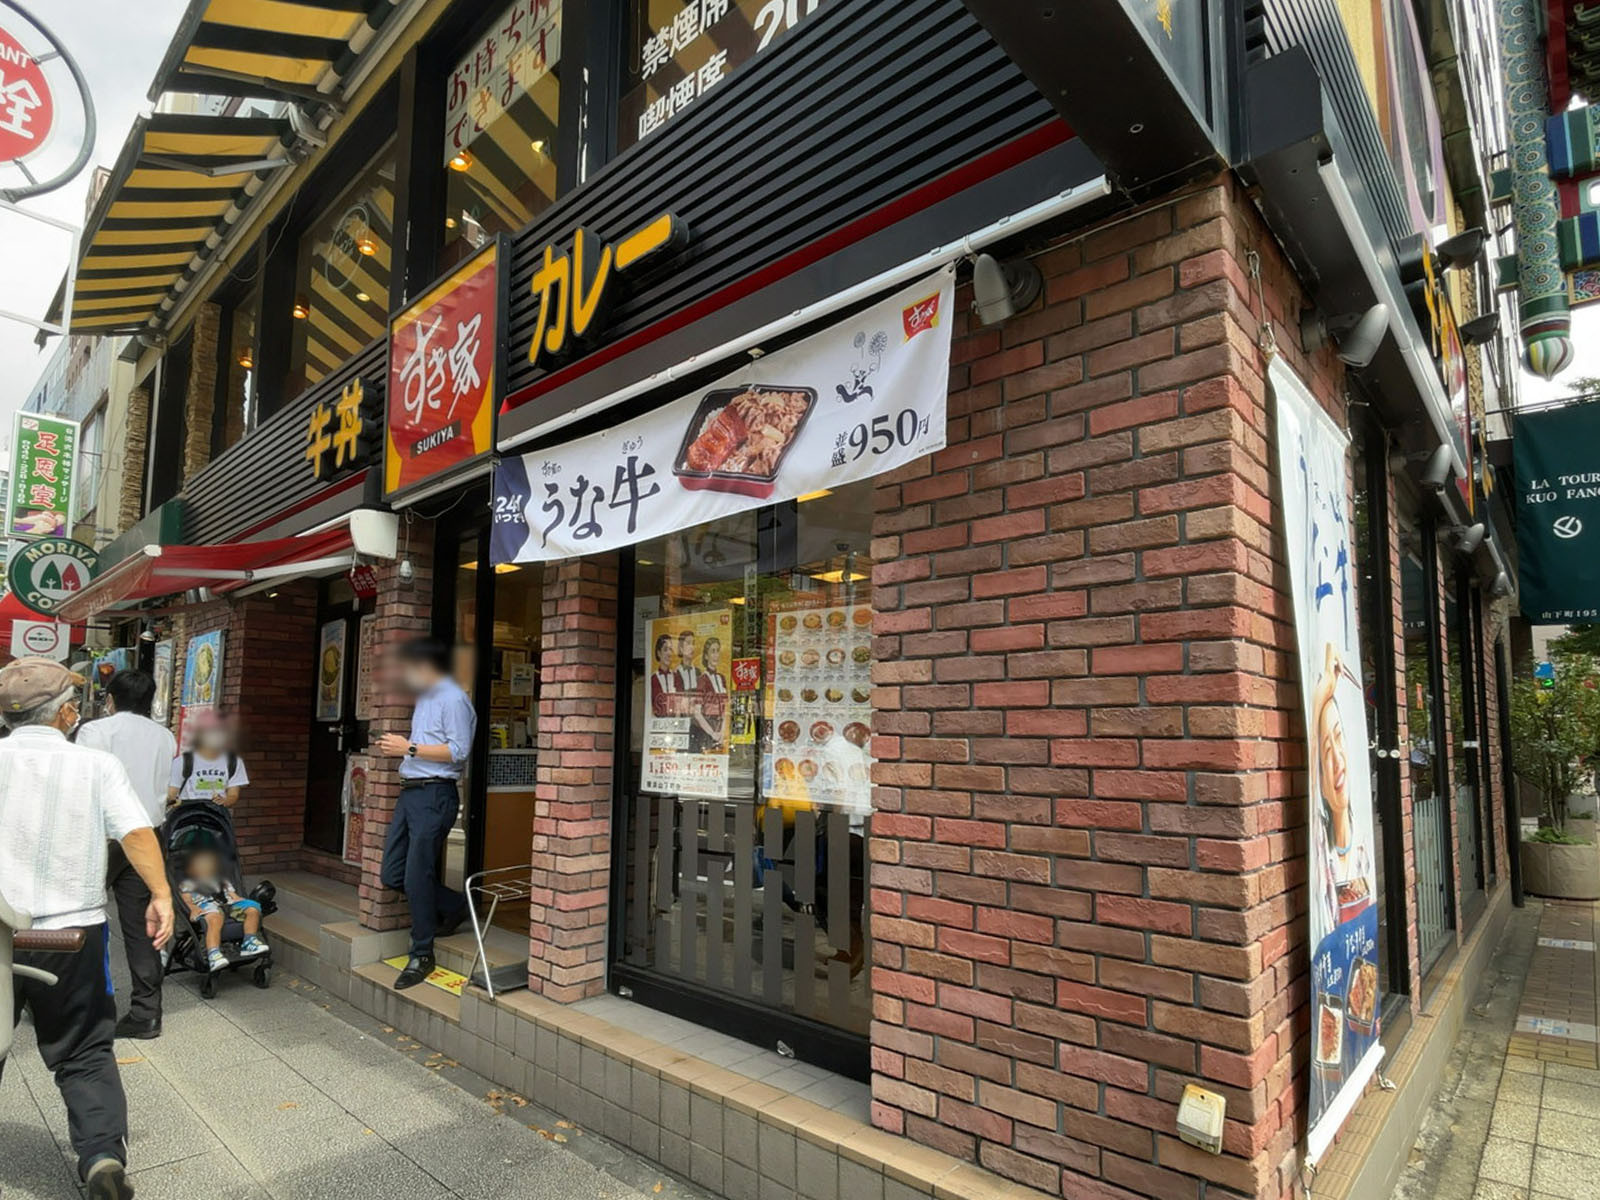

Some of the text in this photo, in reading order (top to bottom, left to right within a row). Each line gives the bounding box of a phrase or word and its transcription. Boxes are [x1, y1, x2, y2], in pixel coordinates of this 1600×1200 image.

[529, 213, 673, 364] カレー
[400, 313, 482, 425] すき家
[306, 377, 364, 479] 牛丼
[416, 426, 454, 455] SUKIYA
[29, 431, 60, 508] 足恩堂
[1531, 473, 1600, 490] LA TOUR
[541, 456, 661, 549] うな牛
[1526, 491, 1558, 504] KUO
[25, 542, 97, 568] MORIVA
[27, 592, 59, 609] CO
